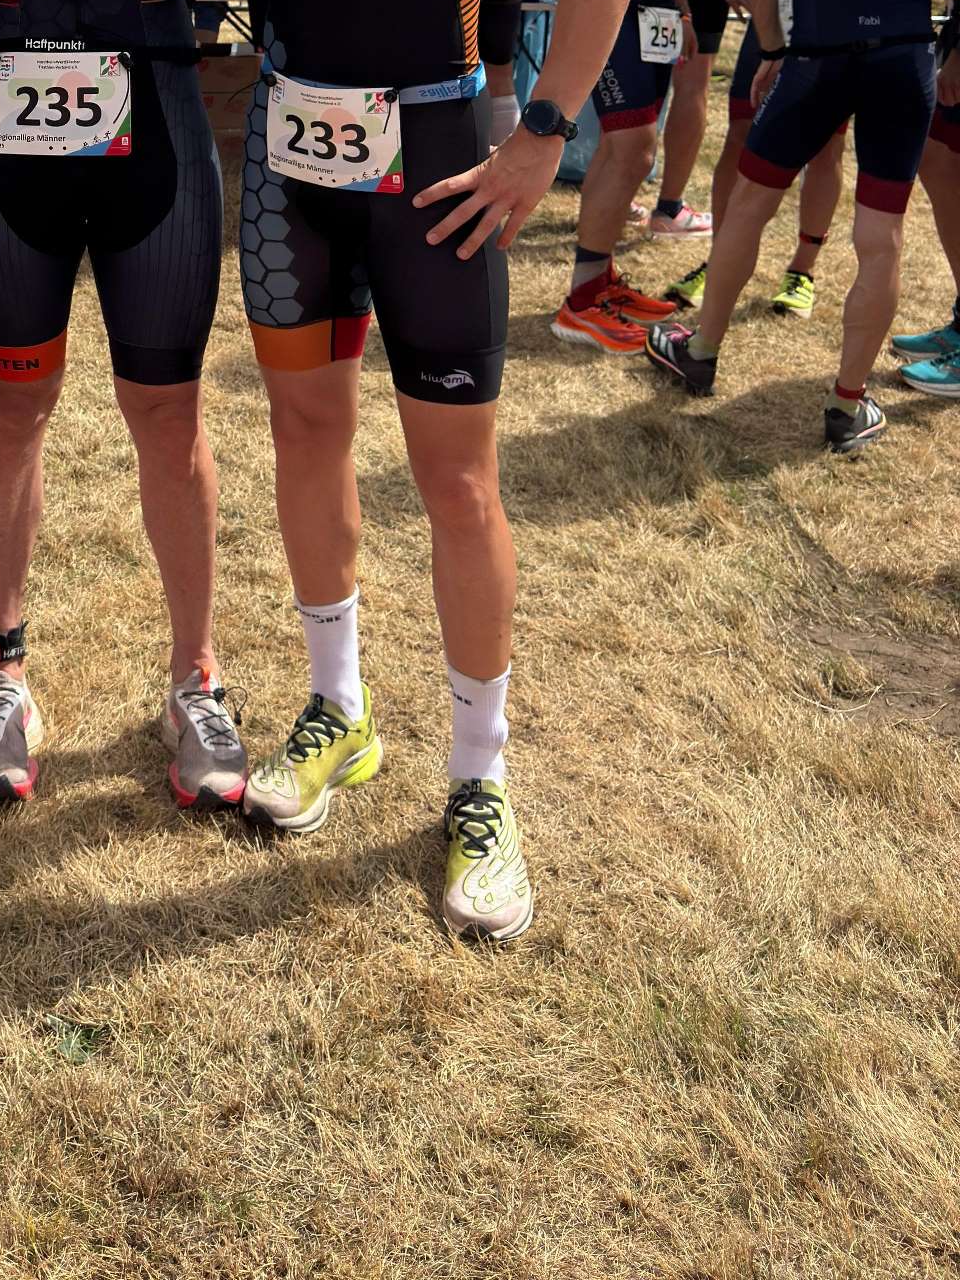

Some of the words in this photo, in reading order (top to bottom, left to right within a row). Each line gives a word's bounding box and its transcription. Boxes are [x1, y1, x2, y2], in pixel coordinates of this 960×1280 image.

[858, 16, 881, 25] Fabi
[650, 26, 677, 48] 254
[602, 69, 626, 105] BONN
[16, 86, 102, 127] 235
[37, 133, 66, 142] Männer
[285, 114, 370, 163] 233
[270, 152, 306, 169] Regionalliga
[306, 163, 334, 175] Männer
